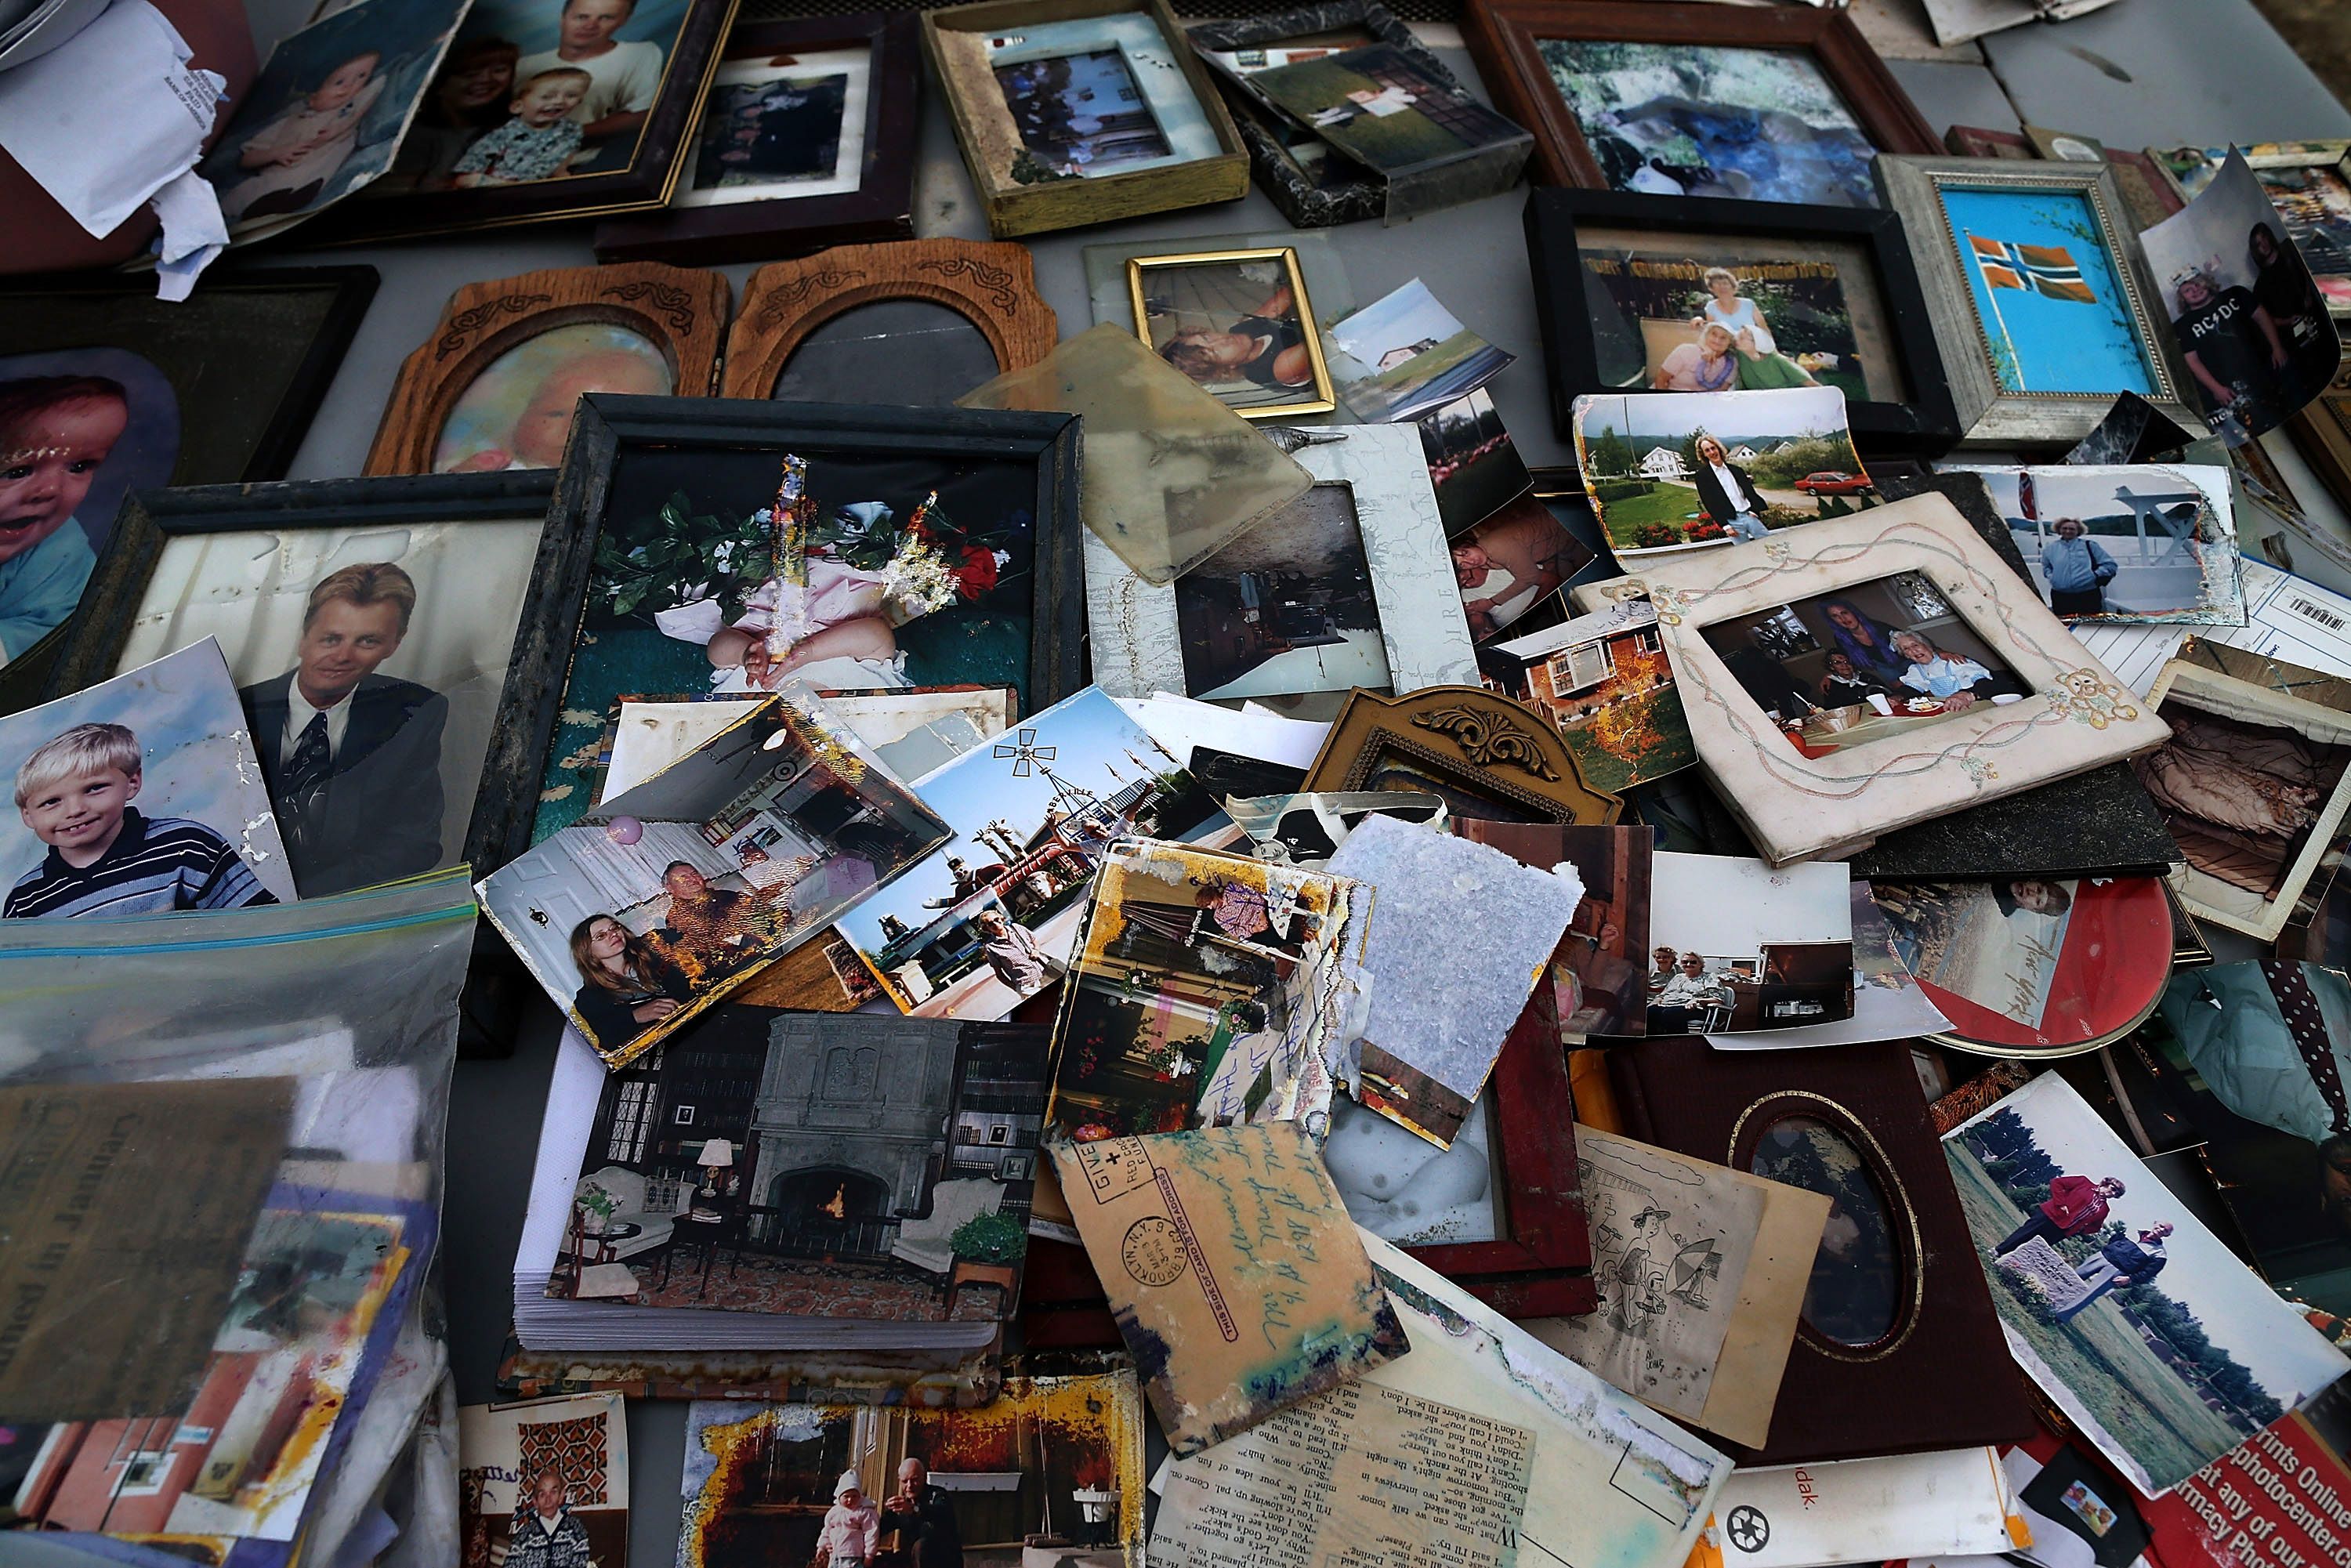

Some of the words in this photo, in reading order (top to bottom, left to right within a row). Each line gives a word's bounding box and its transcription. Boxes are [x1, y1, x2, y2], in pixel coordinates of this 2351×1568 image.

[164, 76, 180, 95] BANK
[185, 103, 206, 130] AMERICA
[185, 91, 201, 108] PAID
[1081, 1144, 1110, 1190] GIVE
[1127, 1160, 1137, 1183] RED
[1157, 1172, 1180, 1215] ADDRESS
[1176, 1215, 1189, 1235] FOR
[1184, 1235, 1194, 1247] IS
[1189, 1245, 1206, 1274] CARD
[1201, 1273, 1212, 1287] OF
[1207, 1287, 1223, 1311] SIDE
[1218, 1311, 1233, 1334] THIS
[1381, 1387, 1403, 1401] don't
[1415, 1399, 1425, 1410] be.
[1428, 1401, 1440, 1414] I'll
[1396, 1405, 1422, 1418] asked.
[1442, 1408, 1465, 1420] where
[1425, 1414, 1438, 1423] she
[1469, 1417, 1491, 1430] know
[1469, 1427, 1484, 1436] call
[1494, 1424, 1516, 1436] don't
[1447, 1432, 1465, 1443] find
[1487, 1432, 1491, 1441] I
[1470, 1439, 1487, 1448] you
[1366, 1451, 1388, 1462] night
[1432, 1449, 1446, 1458] out
[1459, 1447, 1481, 1458] think
[1196, 1454, 1212, 1467] fun,
[1271, 1455, 1291, 1467] now,
[1393, 1459, 1406, 1469] the
[1448, 1454, 1465, 1464] you
[1467, 1459, 1483, 1468] call
[1486, 1454, 1509, 1467] don't
[1170, 1470, 1182, 1479] on.
[1235, 1468, 1252, 1479] idea
[1412, 1465, 1440, 1479] night's
[1453, 1466, 1466, 1476] the
[1484, 1465, 1488, 1473] I
[1185, 1475, 1208, 1489] Come
[1259, 1476, 1281, 1487] your
[1361, 1472, 1369, 1481] in
[1470, 1472, 1482, 1481] At
[2255, 1428, 2301, 1475] rints
[2297, 1465, 2351, 1530] Online
[1215, 1483, 1230, 1494] pal.
[1287, 1484, 1296, 1494] be
[1375, 1476, 1417, 1496] interviews
[1446, 1476, 1488, 1494] tomorrow
[1489, 1476, 1527, 1497] shooting.
[1795, 1466, 1817, 1510] dak.
[1234, 1490, 1247, 1500] up,
[1357, 1494, 1385, 1508] tomor-
[1422, 1490, 1438, 1501] two
[1465, 1491, 1508, 1509] morning,
[1249, 1494, 1283, 1512] slowing
[1301, 1499, 1311, 1510] be
[1423, 1501, 1449, 1514] asked.
[1444, 1496, 1465, 1509] those
[1316, 1503, 1331, 1515] It'll
[1392, 1504, 1408, 1515] talk
[1471, 1505, 1485, 1514] got
[1509, 1505, 1523, 1516] the
[2174, 1480, 2233, 1541] rmacy
[1231, 1512, 1244, 1523] the
[1248, 1517, 1262, 1526] see
[1287, 1518, 1291, 1526] I
[1433, 1516, 1447, 1525] can
[1453, 1511, 1467, 1521] she
[2196, 1465, 2222, 1488] at
[2218, 1482, 2253, 1522] any
[2248, 1515, 2277, 1541] of
[2269, 1536, 2306, 1568] our
[1237, 1525, 1261, 1540] God's
[1265, 1522, 1288, 1536] don't
[1454, 1522, 1473, 1534] time
[1150, 1532, 1172, 1544] said.
[1266, 1534, 1279, 1545] for
[1480, 1525, 1520, 1549] What
[1176, 1541, 1186, 1551] he
[1248, 1541, 1270, 1555] Let's
[1454, 1545, 1467, 1557] I'll
[1211, 1552, 1246, 1567] planned
[1471, 1550, 1490, 1561] said
